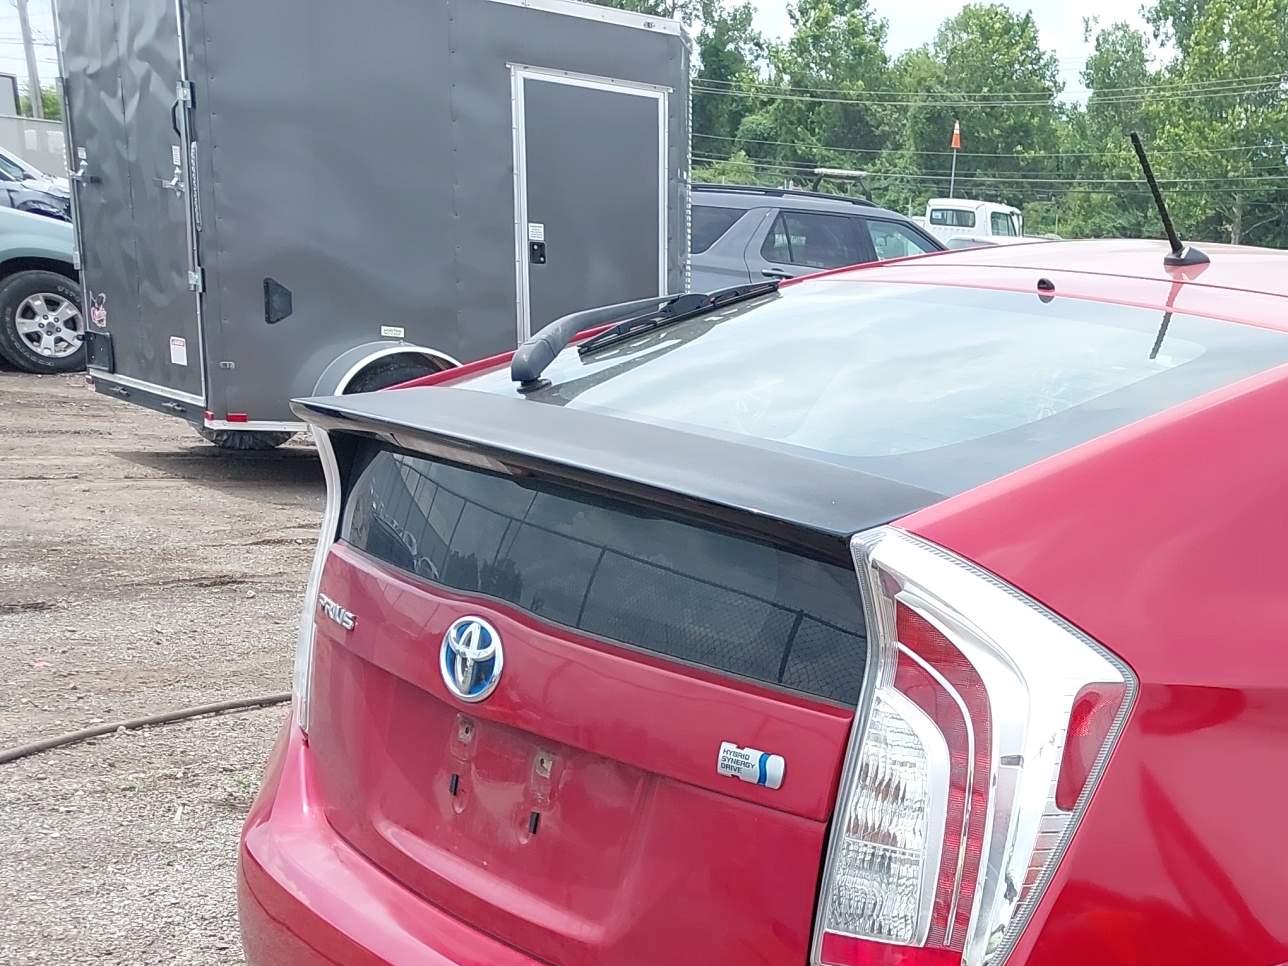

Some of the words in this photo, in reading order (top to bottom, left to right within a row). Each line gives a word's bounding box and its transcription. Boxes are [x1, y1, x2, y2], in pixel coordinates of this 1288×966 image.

[723, 749, 750, 761] HYBRID
[721, 755, 755, 769] SYNERGY
[720, 763, 743, 774] DRIVE
